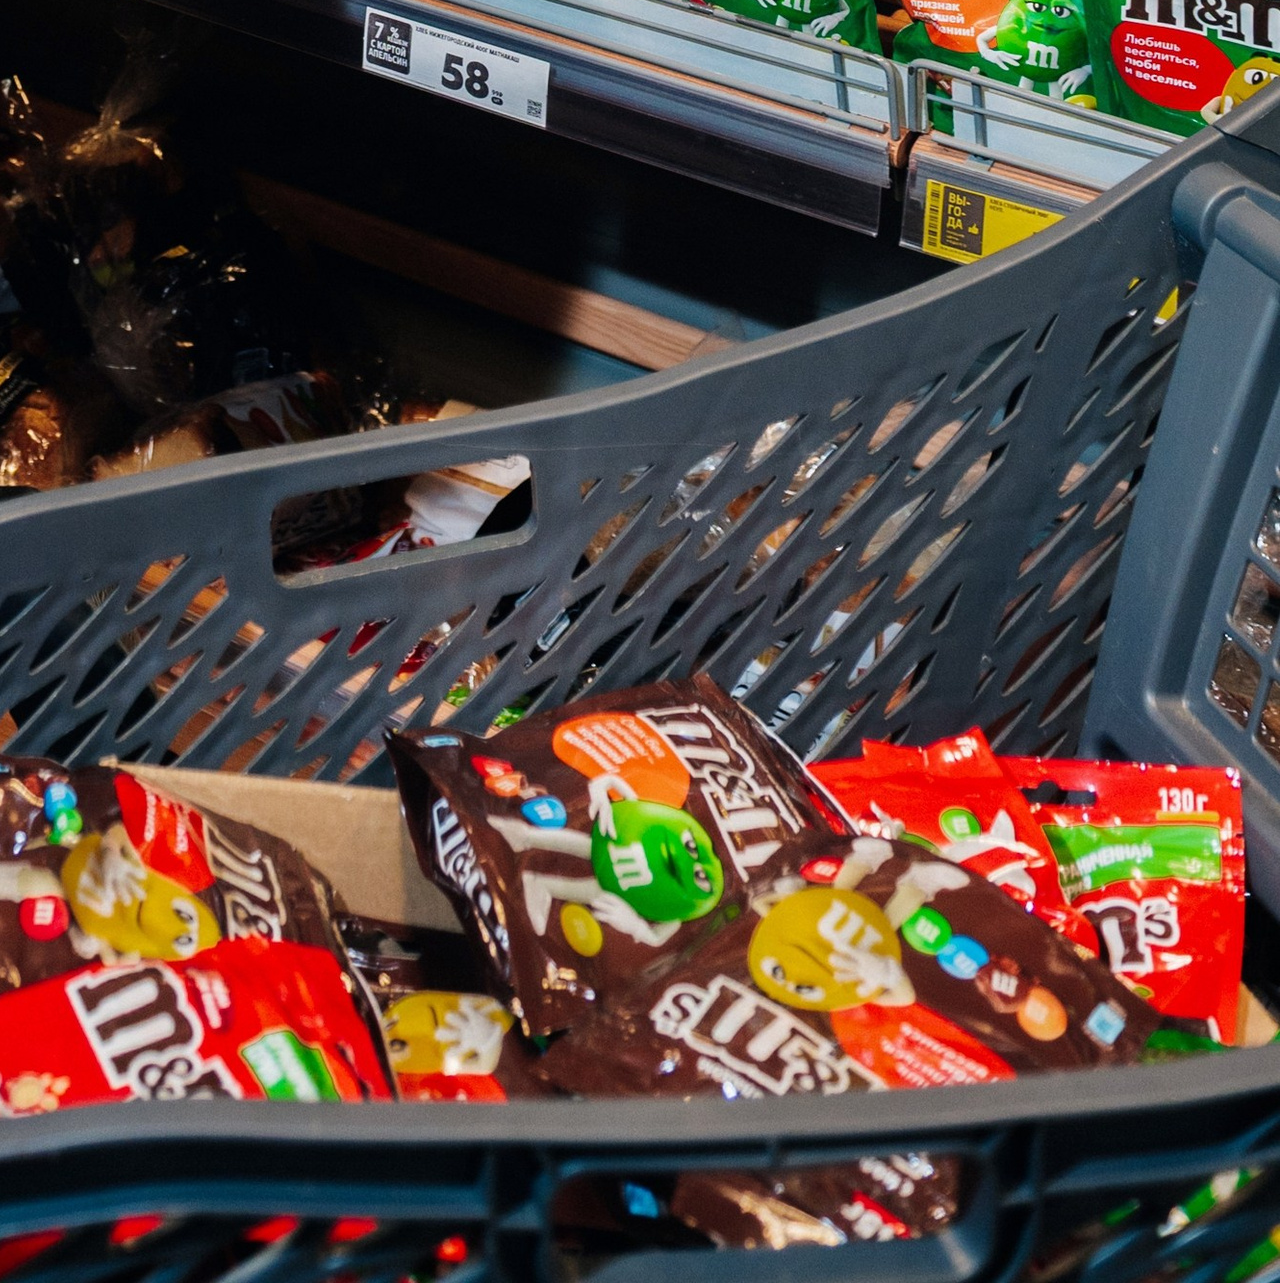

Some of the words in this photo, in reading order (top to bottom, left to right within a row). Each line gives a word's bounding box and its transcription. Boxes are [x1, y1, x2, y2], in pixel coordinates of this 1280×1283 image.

[377, 41, 407, 57] КАРТОЙ
[429, 29, 475, 49] НИЖЕГОРОДСКИЙ
[490, 48, 520, 63] МАТНАКАШ
[1125, 33, 1181, 52] Любишь
[368, 49, 408, 67] АПЕЛЬСИН
[1125, 44, 1200, 69] веселиться,
[1125, 56, 1161, 72] люби
[442, 53, 489, 99] 58
[948, 192, 972, 206] ВЫ-
[947, 206, 966, 217] ГО-
[946, 216, 963, 230] ДА
